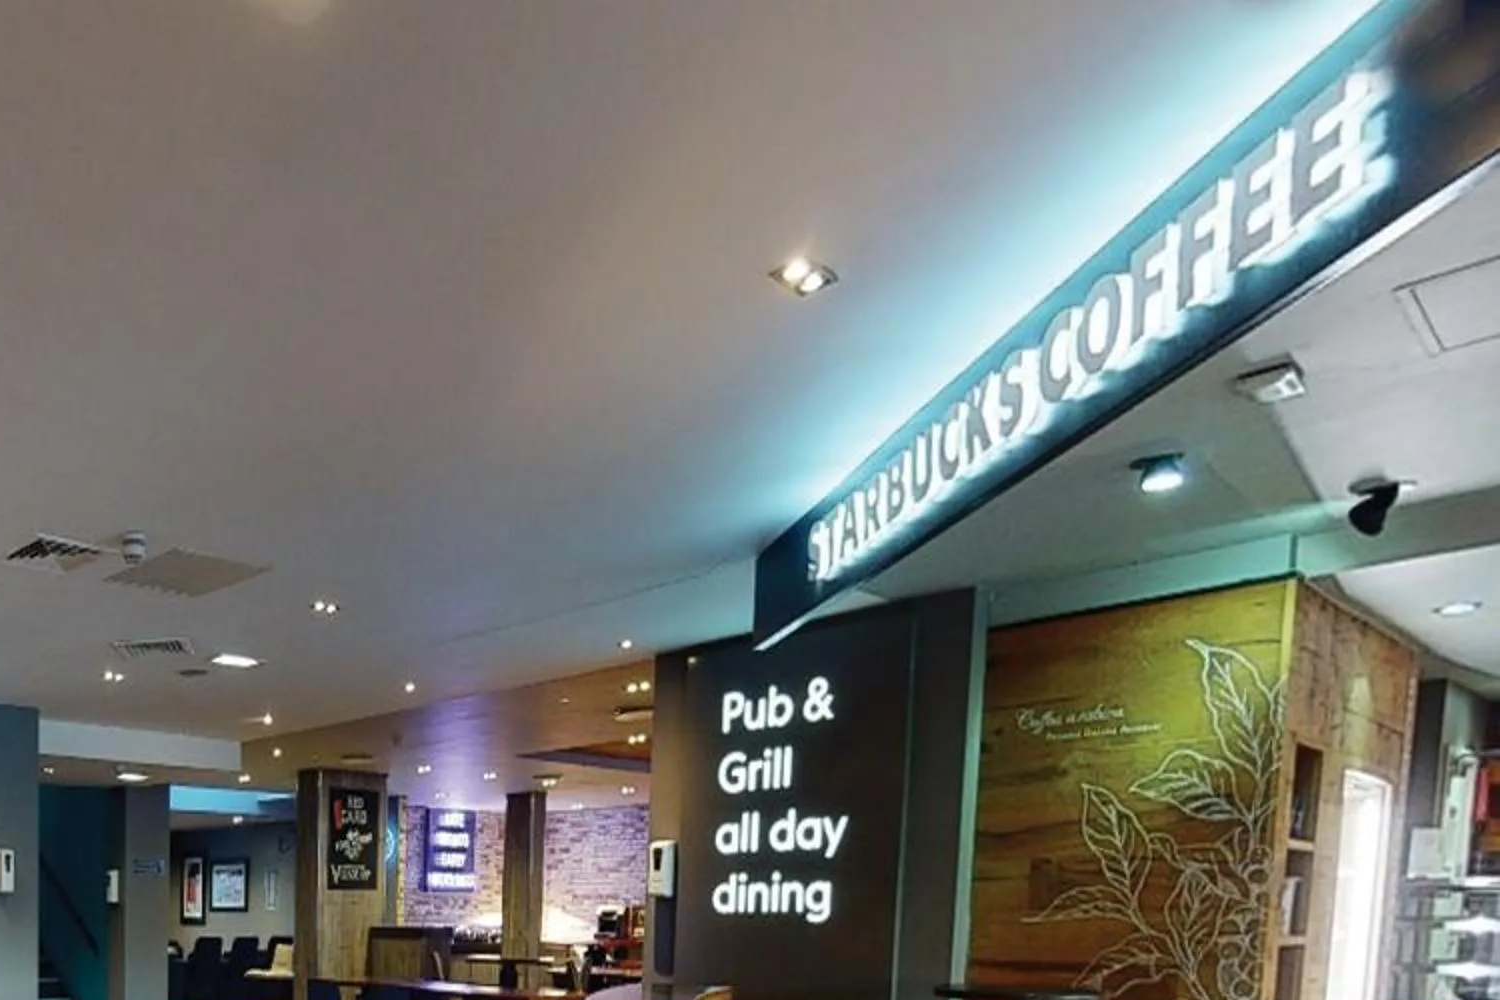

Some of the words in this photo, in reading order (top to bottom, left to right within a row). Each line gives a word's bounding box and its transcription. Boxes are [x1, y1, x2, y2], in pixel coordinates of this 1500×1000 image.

[809, 347, 1040, 579] STARBUCKS
[1039, 68, 1392, 402] COFFEE
[721, 684, 794, 734] Pub
[802, 676, 835, 722] &
[717, 745, 793, 794] Grill
[714, 810, 760, 854] all
[768, 807, 849, 859] day
[711, 869, 832, 924] dining
